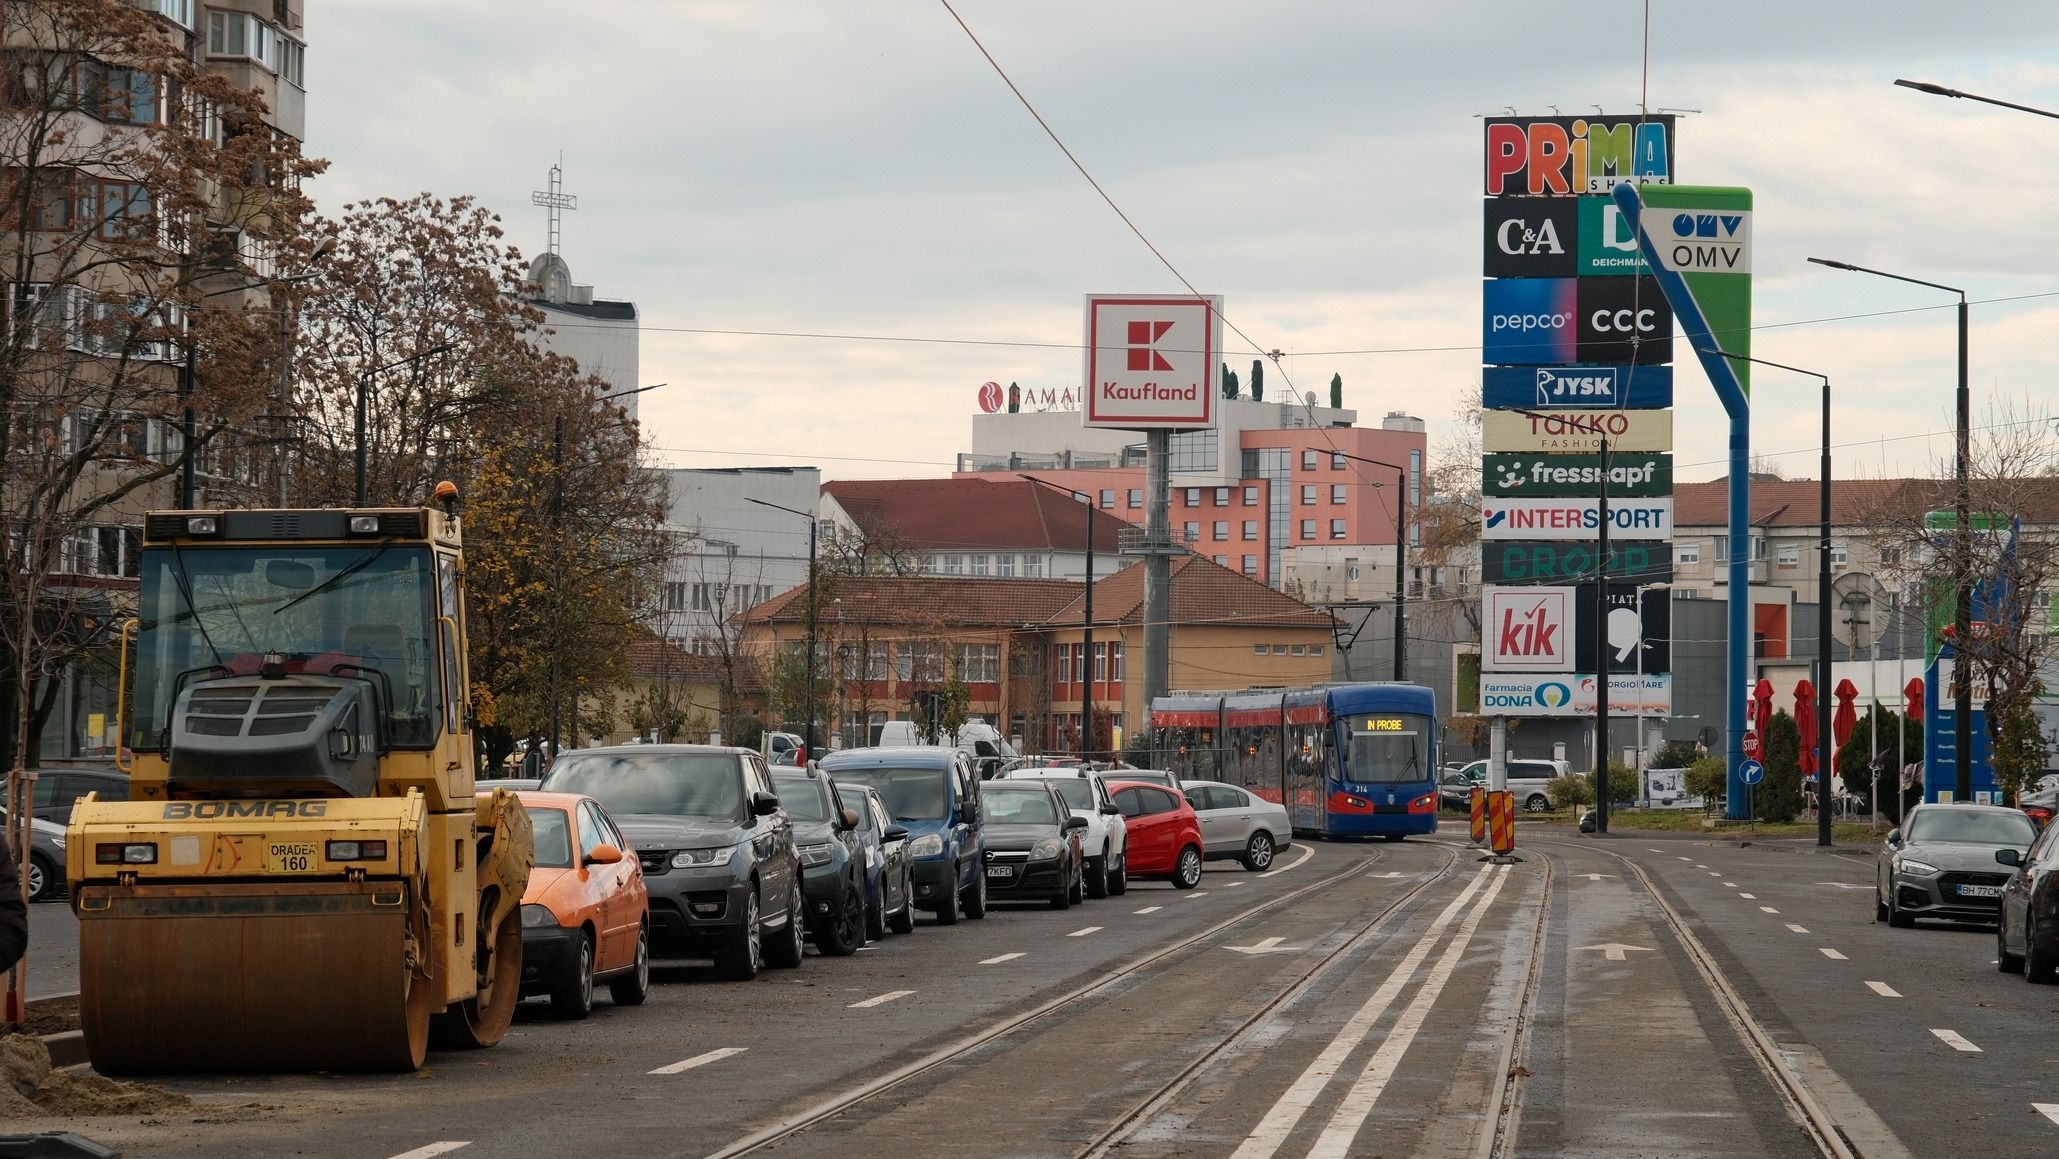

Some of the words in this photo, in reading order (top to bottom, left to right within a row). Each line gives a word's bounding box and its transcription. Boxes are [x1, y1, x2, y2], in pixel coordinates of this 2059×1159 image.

[1497, 218, 1565, 255] C&A
[1592, 258, 1649, 267] DEICHMAN
[1672, 245, 1741, 268] OMV
[1103, 382, 1197, 401] Kaufland
[1553, 377, 1612, 395] JYSK
[1541, 439, 1613, 448] FASHION
[1531, 461, 1656, 488] fressnapf
[1484, 683, 1533, 692] Farmacia
[1484, 695, 1533, 707] DONA
[1367, 719, 1375, 730] IN
[1376, 719, 1402, 730] PROBE
[1743, 740, 1758, 751] STOP
[162, 800, 328, 819] BOMAG
[271, 844, 317, 857] ORADEA
[280, 856, 308, 871] 160
[1962, 886, 1975, 895] BH
